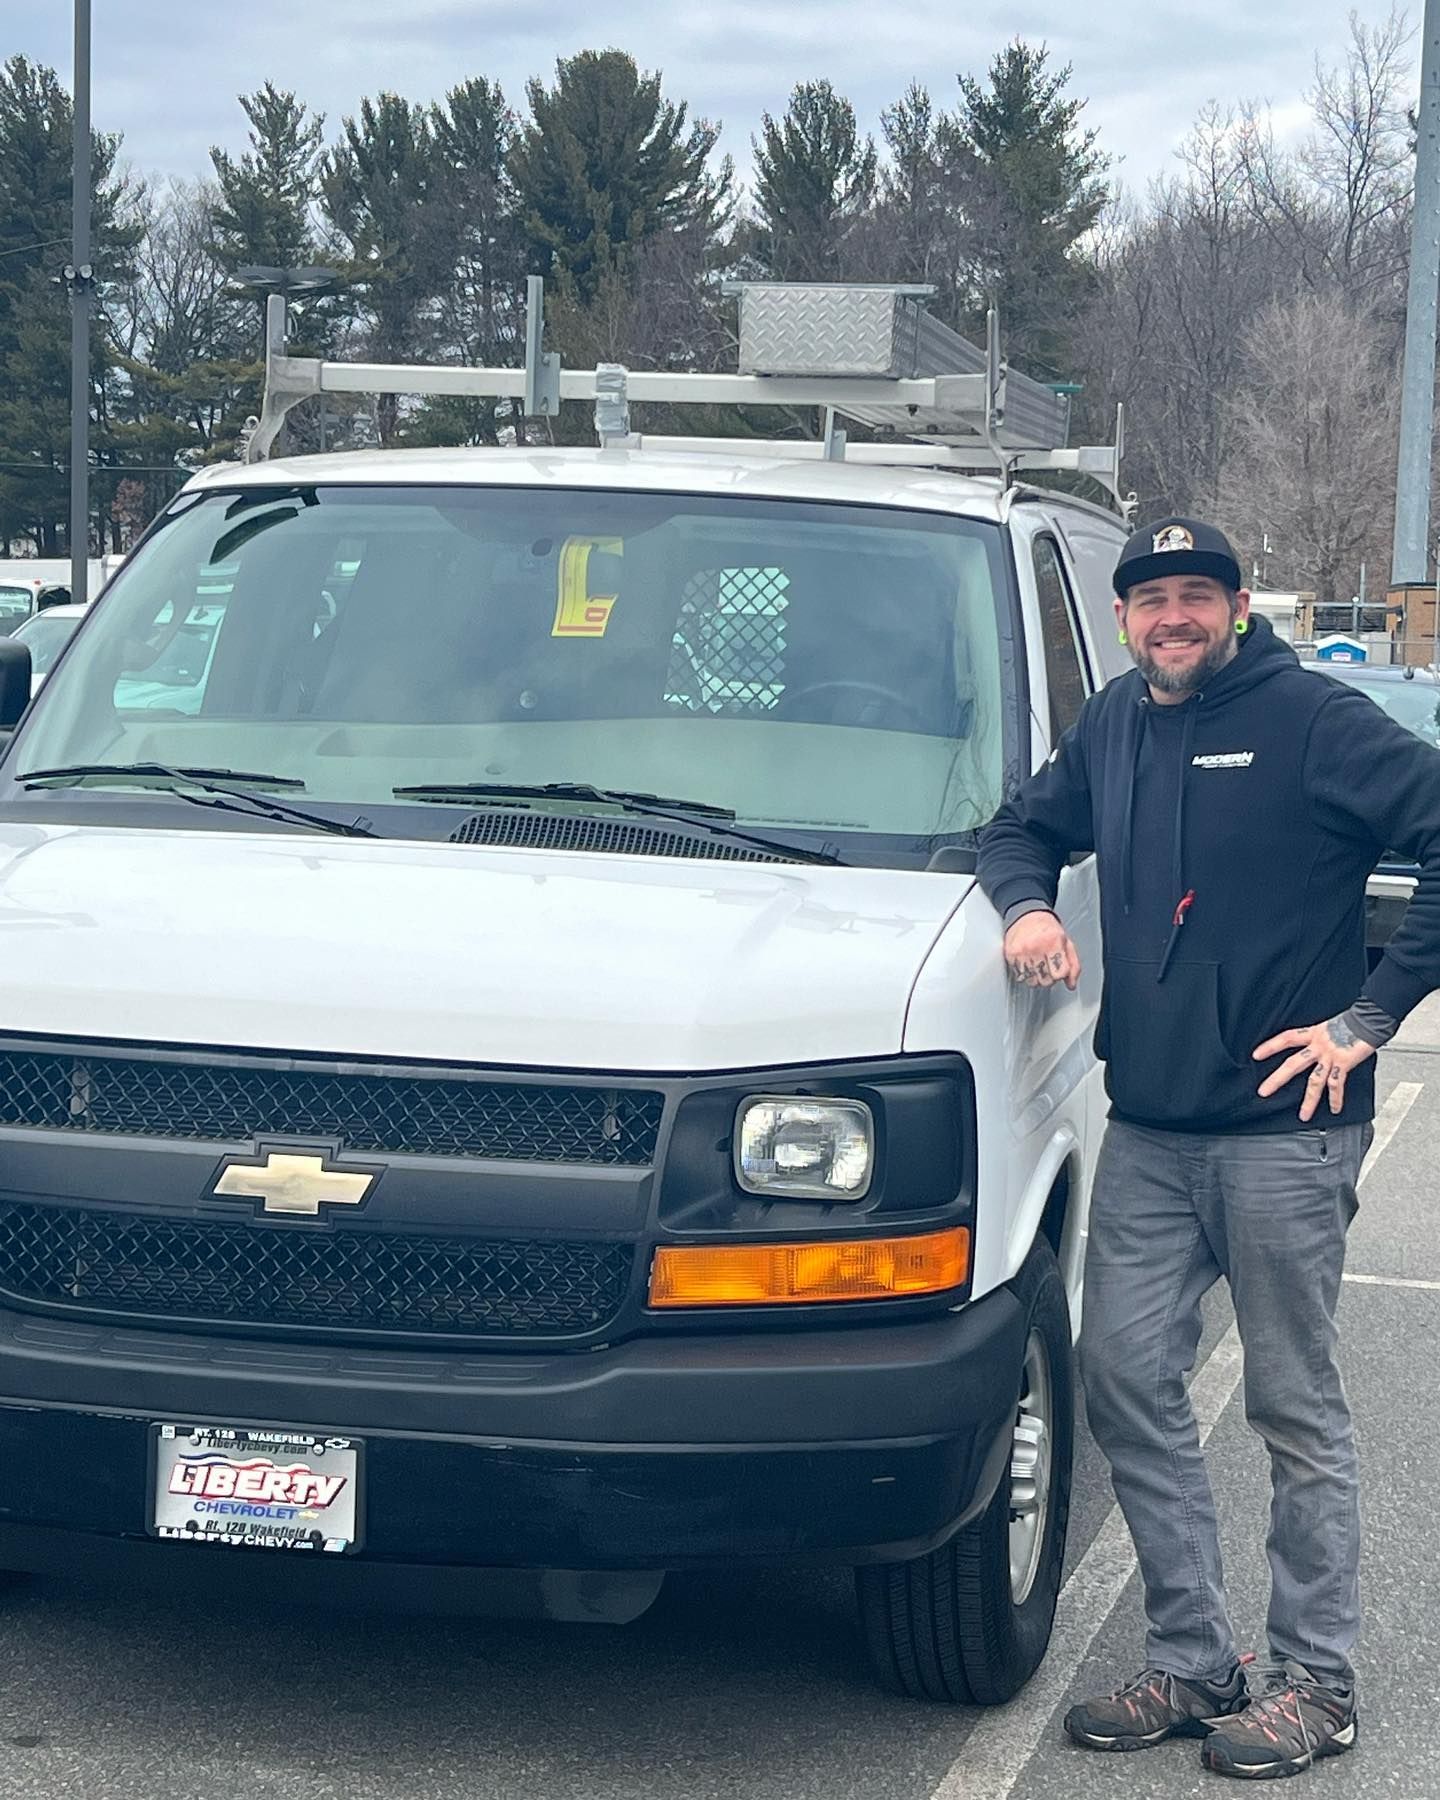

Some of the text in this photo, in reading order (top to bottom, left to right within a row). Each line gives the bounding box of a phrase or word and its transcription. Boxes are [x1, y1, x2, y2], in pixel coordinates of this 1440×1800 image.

[1192, 751, 1254, 765] MODERN
[214, 1429, 236, 1440] 128
[247, 1432, 315, 1446] WAKEFIELD
[168, 1463, 348, 1508] LIBERTY
[193, 1501, 298, 1520] CHEVROLET
[250, 1523, 307, 1539] Wakefield
